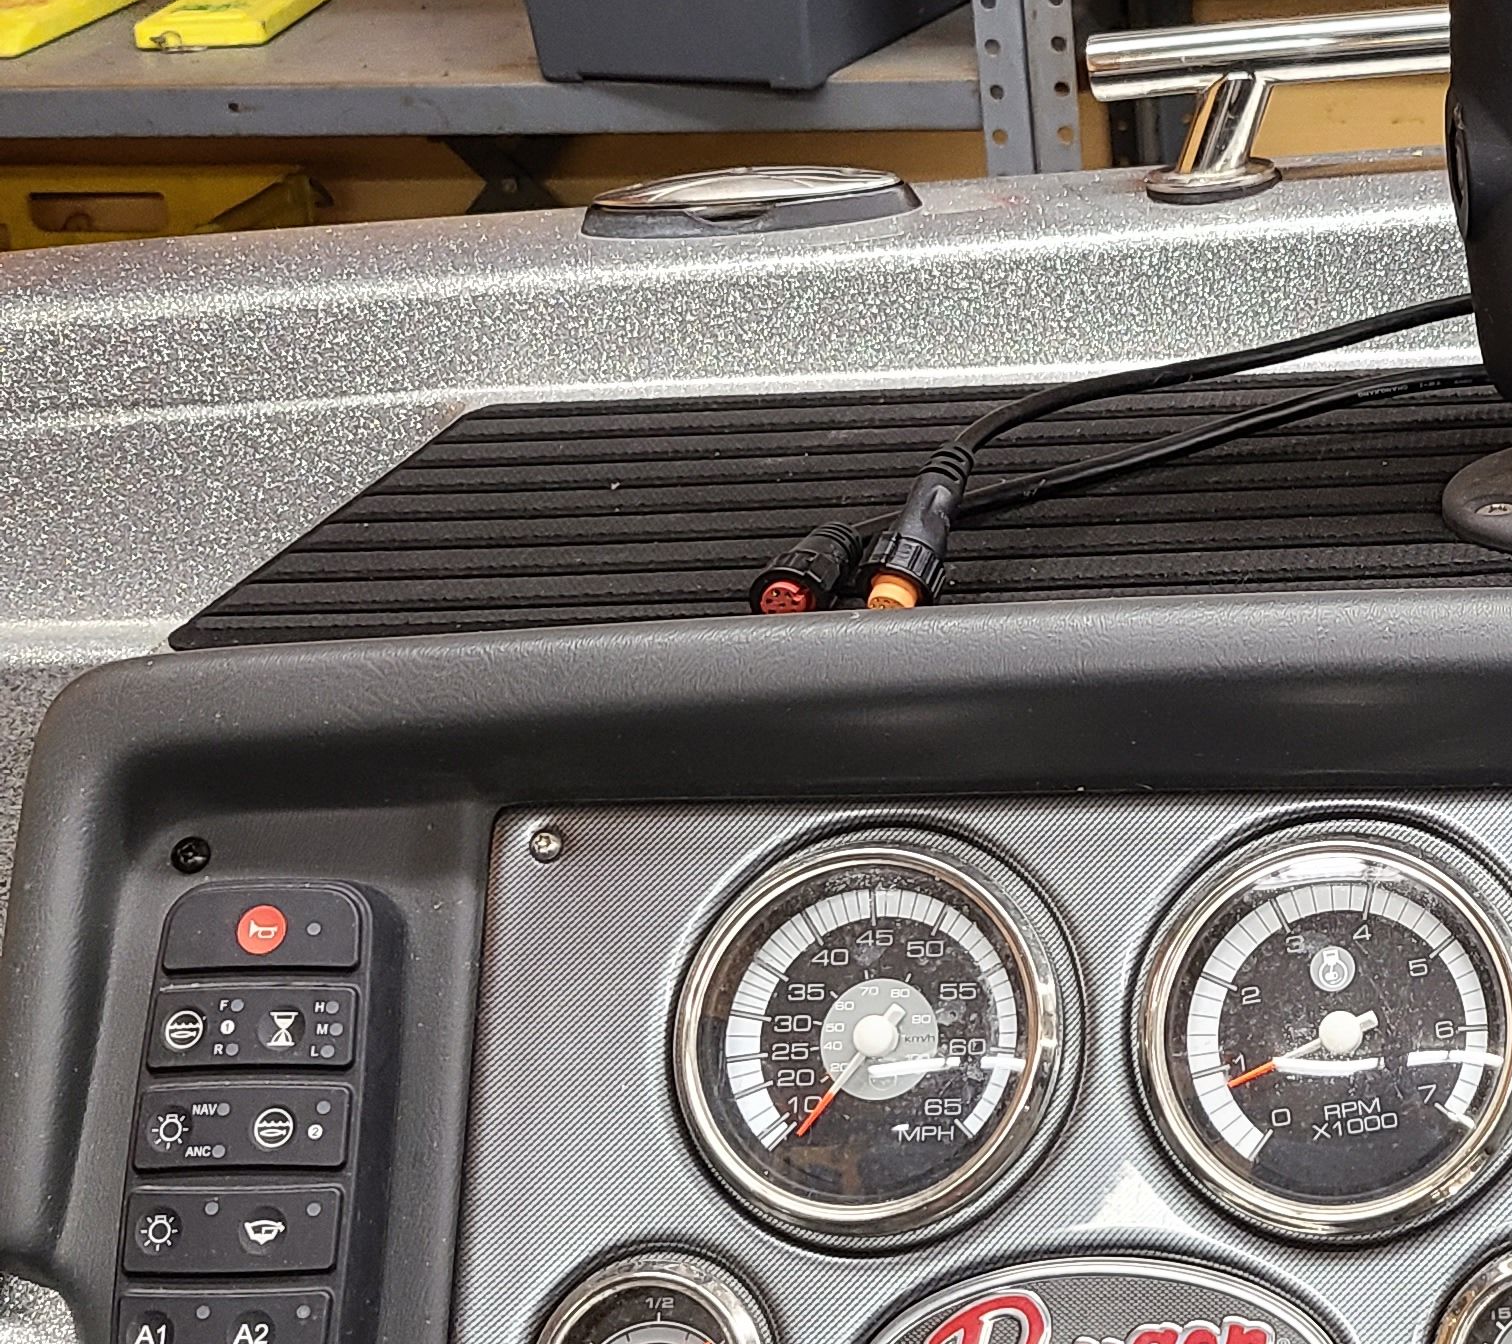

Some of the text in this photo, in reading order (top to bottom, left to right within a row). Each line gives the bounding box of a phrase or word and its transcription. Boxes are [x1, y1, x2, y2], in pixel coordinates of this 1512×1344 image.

[856, 930, 894, 946] 45
[1353, 925, 1371, 941] 4
[906, 941, 944, 957] 50
[1286, 936, 1304, 953] 3
[811, 949, 849, 966] 40
[1409, 959, 1428, 976] 5
[788, 984, 825, 1001] 35
[860, 986, 879, 996] 70
[940, 984, 977, 1000] 55
[1241, 987, 1262, 1004] 2
[220, 1000, 229, 1011] F
[315, 1001, 325, 1013] H
[316, 1023, 328, 1035] M
[774, 1016, 811, 1032] 30
[825, 1023, 844, 1033] 50
[1435, 1022, 1454, 1038] 6
[823, 1041, 843, 1051] 40
[904, 1034, 936, 1044] km/h
[213, 1044, 223, 1055] R
[310, 1045, 319, 1057] L
[772, 1043, 810, 1060] 25
[949, 1039, 986, 1056] 60
[1235, 1056, 1246, 1071] 1
[777, 1070, 815, 1086] 20
[1418, 1085, 1437, 1103] 7
[192, 1104, 218, 1116] NAV
[788, 1097, 826, 1114] 10
[924, 1099, 962, 1116] 65
[1323, 1098, 1381, 1121] RPM
[1272, 1109, 1291, 1126] 0
[899, 1125, 954, 1142] MPH
[1312, 1112, 1398, 1140] X1000
[185, 1145, 212, 1157] ANC
[645, 1297, 674, 1309] 1/2
[1491, 1308, 1511, 1321] 15
